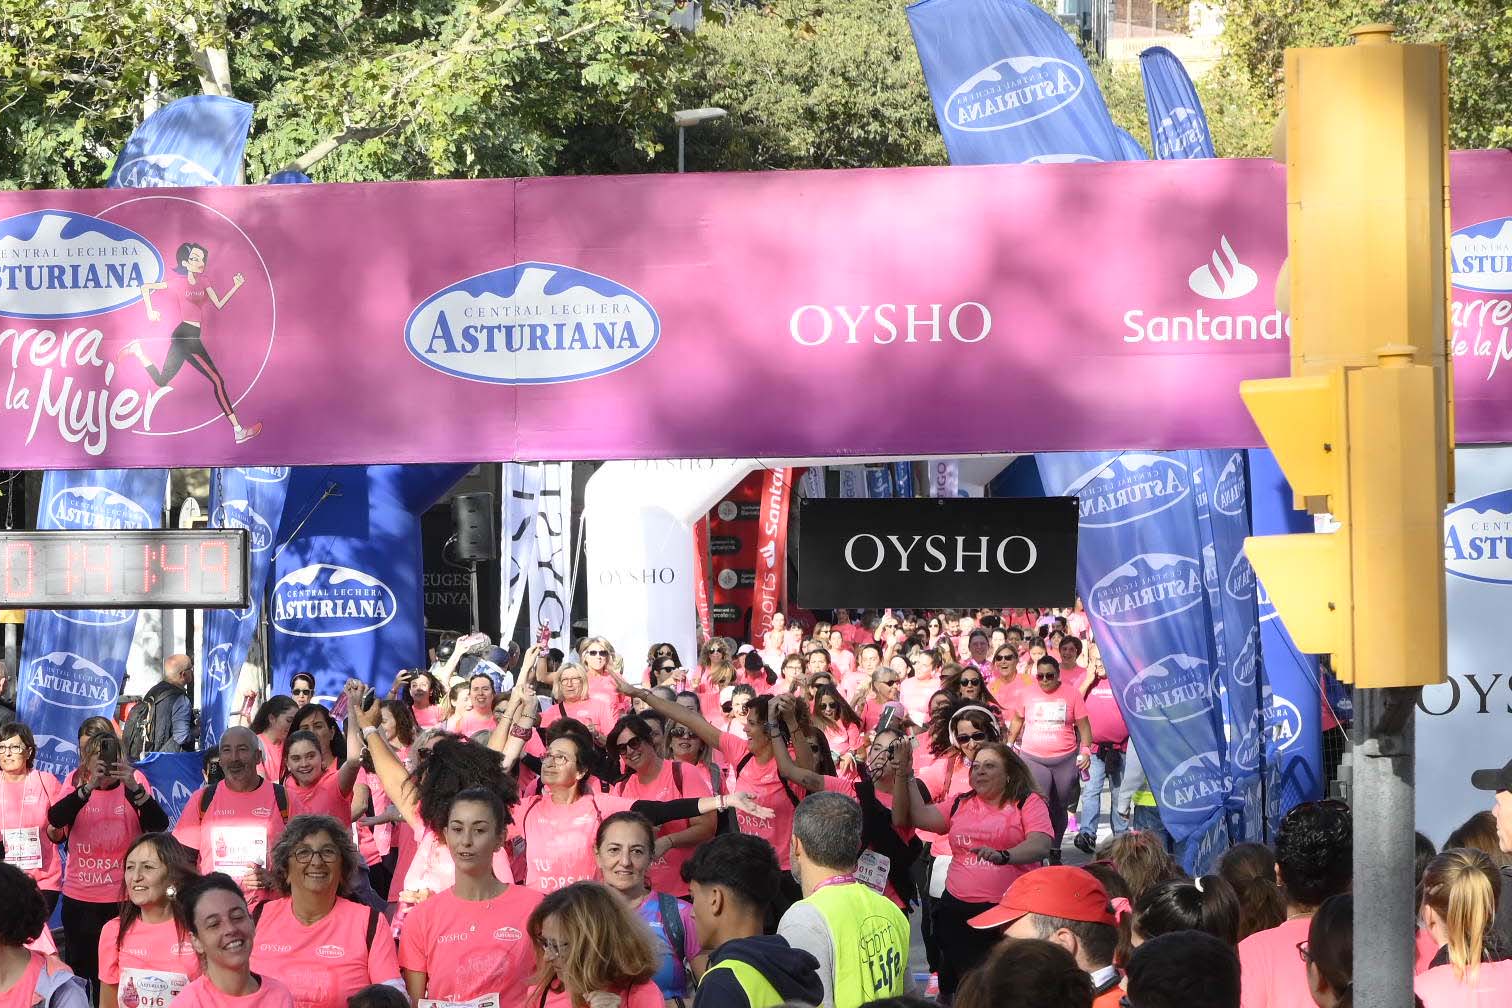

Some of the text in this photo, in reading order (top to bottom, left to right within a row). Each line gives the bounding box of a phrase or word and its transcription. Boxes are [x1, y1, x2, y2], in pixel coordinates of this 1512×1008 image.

[67, 246, 139, 257] LECHERA
[464, 303, 632, 320] CENTRAL LECHERA
[790, 301, 992, 346] OYSHO
[425, 310, 640, 354] ASTURIANA
[1473, 327, 1492, 356] la
[5, 368, 30, 410] la
[25, 361, 174, 456] Mujer
[844, 533, 1038, 574] OYSHO
[287, 587, 383, 598] CENTRAL LECHERA
[275, 591, 387, 621] ASTURIANA
[738, 816, 774, 830] ORSAL
[955, 834, 972, 846] TU
[77, 843, 91, 854] TU
[79, 858, 124, 868] DORSA
[535, 858, 551, 872] TU
[962, 856, 994, 867] SUM
[78, 873, 113, 884] SUMA
[260, 943, 292, 952] OYSHO
[868, 946, 901, 992] Life
[141, 997, 165, 1007] 016
